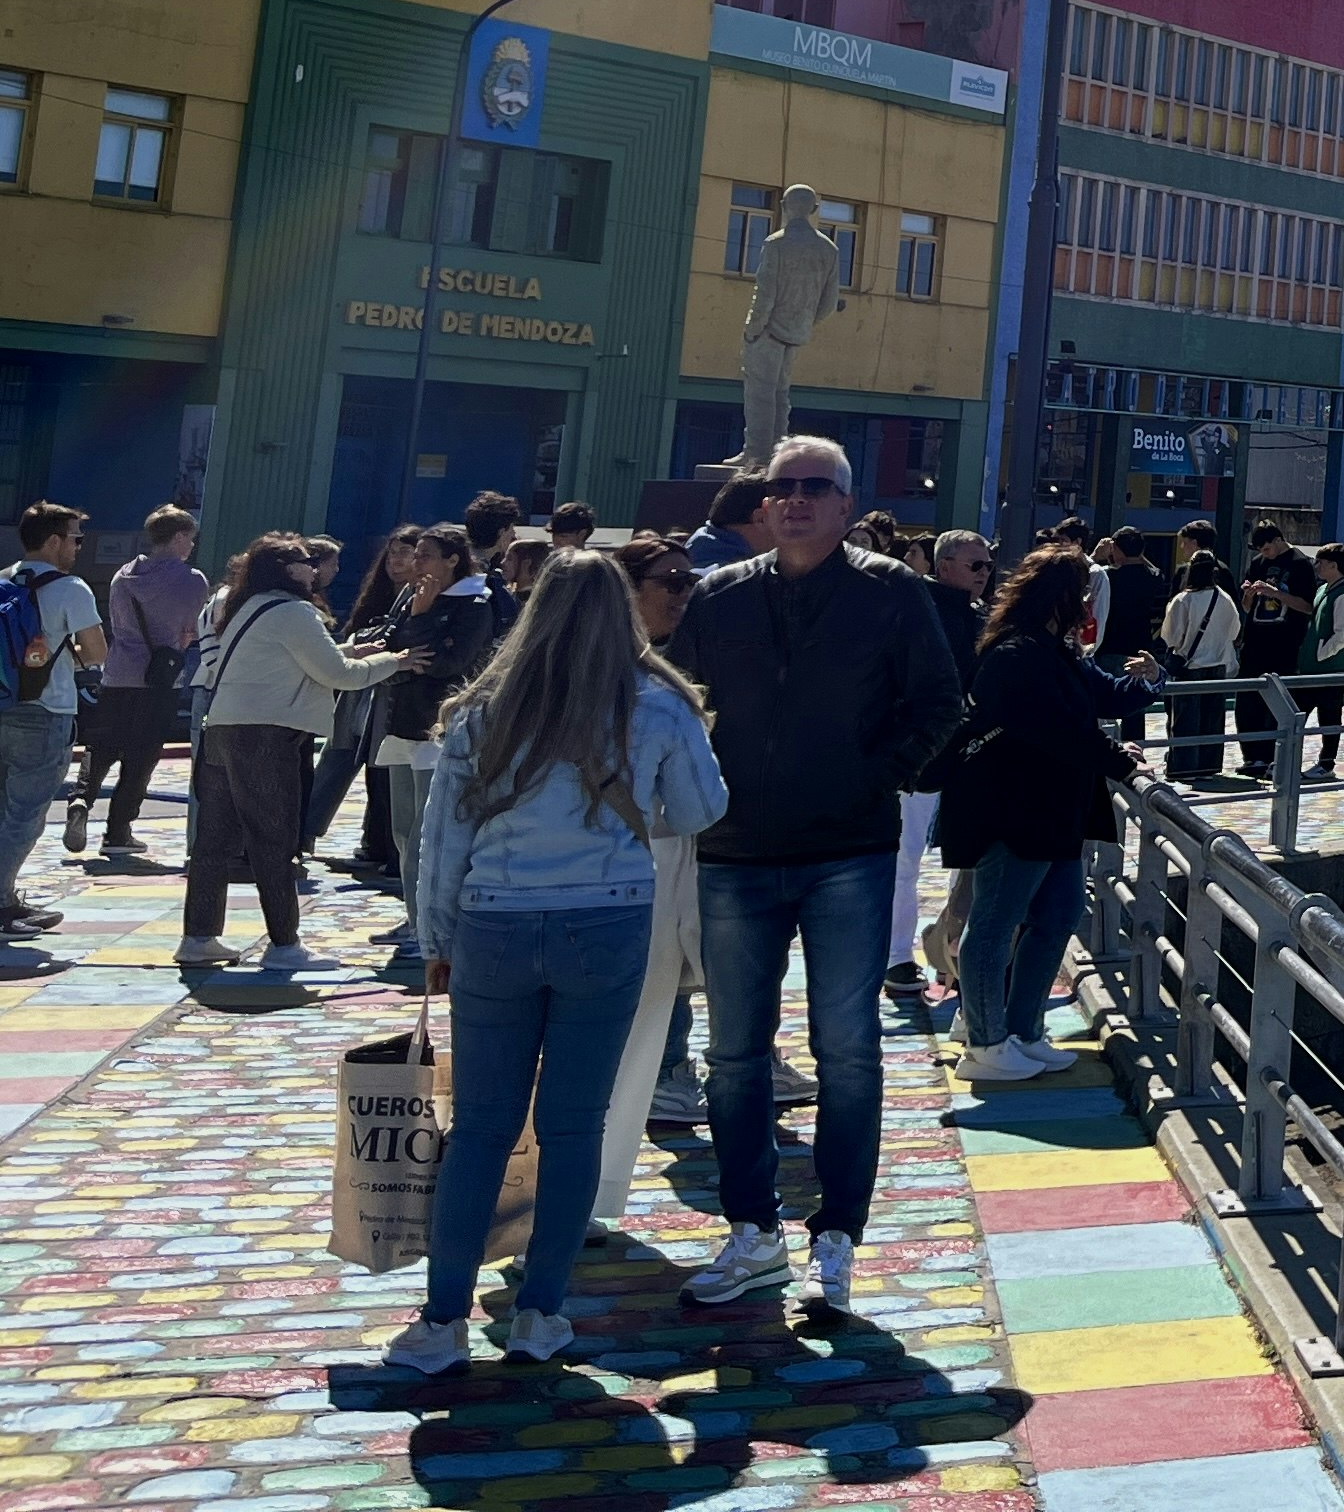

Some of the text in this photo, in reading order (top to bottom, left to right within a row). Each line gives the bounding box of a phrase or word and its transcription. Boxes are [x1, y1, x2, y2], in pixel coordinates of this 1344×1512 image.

[793, 26, 872, 68] MBQM
[762, 48, 790, 65] MUSEO
[792, 55, 821, 71] BENITO
[421, 266, 542, 301] ESCUELA
[442, 310, 474, 335] DE
[480, 313, 595, 347] MENDOZA
[1133, 428, 1185, 451] Benito
[1151, 452, 1184, 462] de La Boca
[348, 1095, 435, 1119] CUEROS
[371, 1182, 411, 1193] SOMOS
